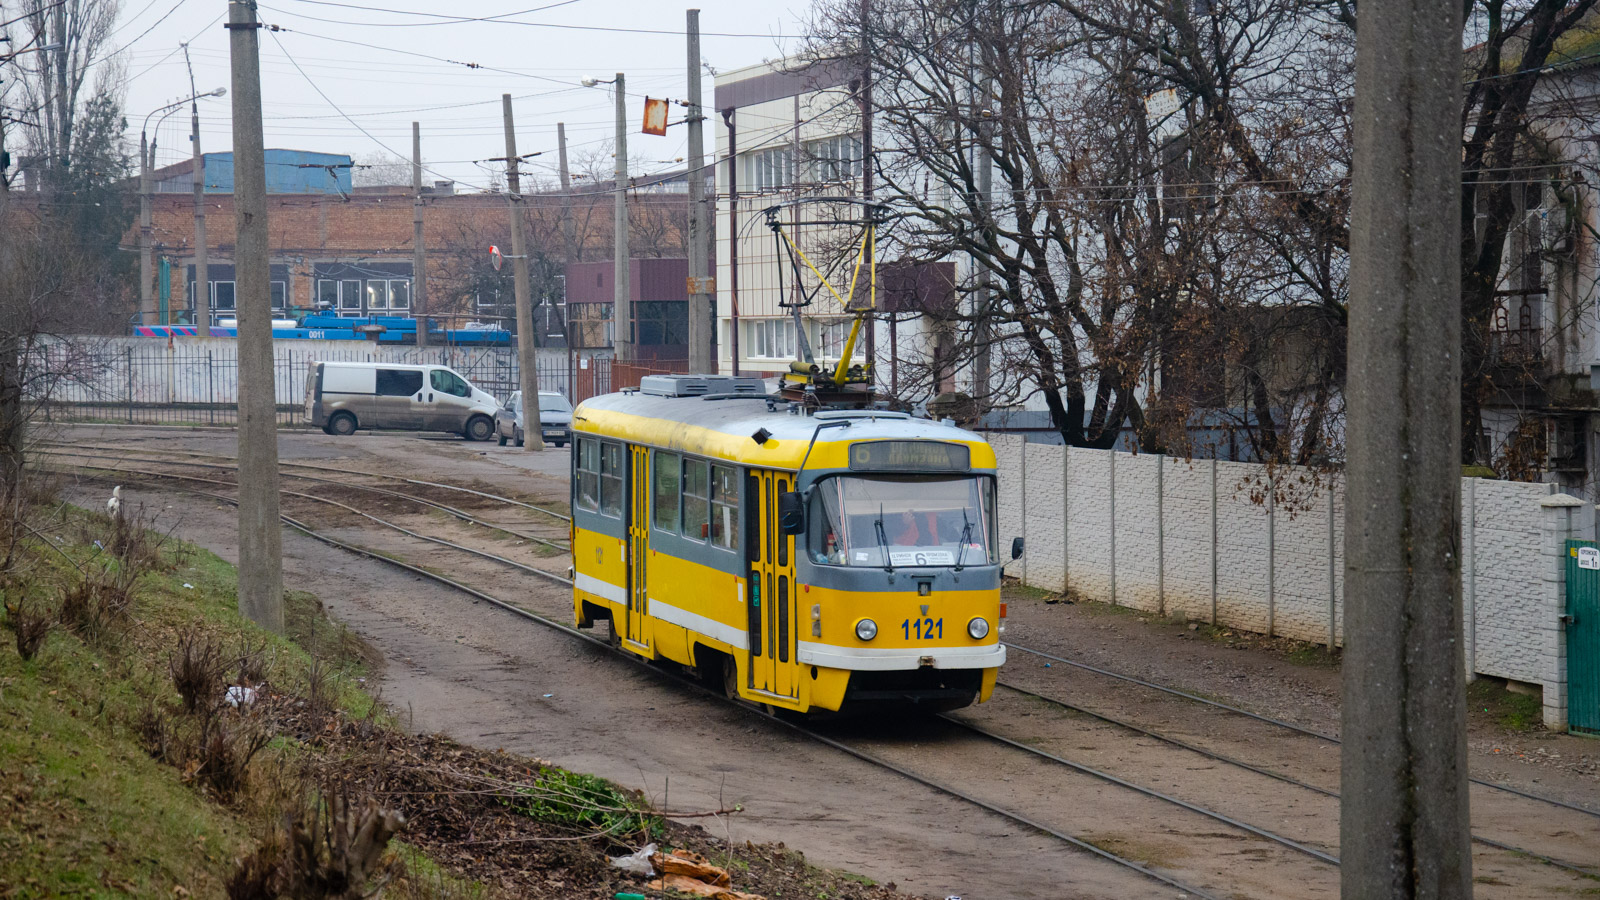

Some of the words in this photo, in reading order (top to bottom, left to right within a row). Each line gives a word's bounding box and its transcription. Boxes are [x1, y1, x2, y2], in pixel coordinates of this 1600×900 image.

[309, 331, 324, 339] 0011
[855, 444, 870, 464] 6
[915, 552, 927, 565] 6
[902, 618, 942, 640] 1121
